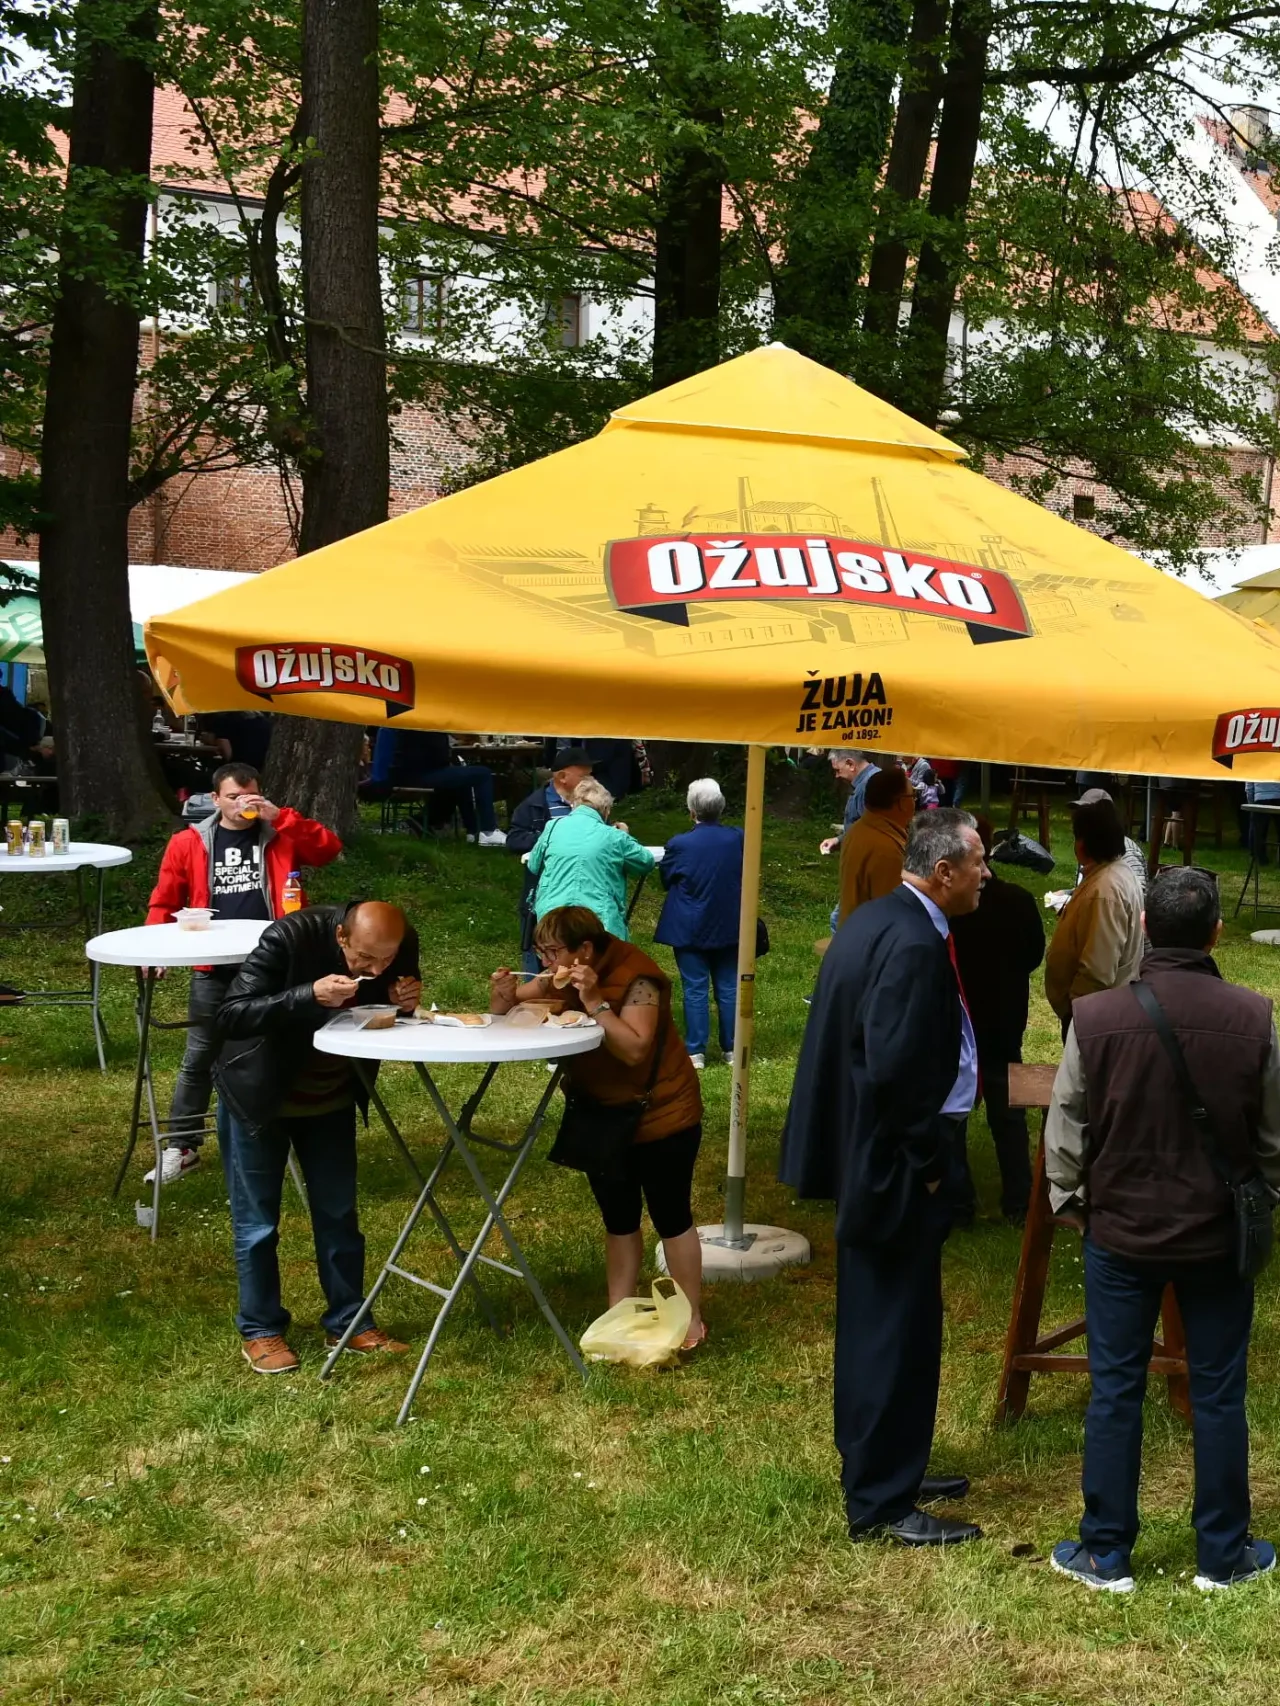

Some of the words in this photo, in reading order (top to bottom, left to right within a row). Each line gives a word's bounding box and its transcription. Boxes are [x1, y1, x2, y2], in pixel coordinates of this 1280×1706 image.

[647, 539, 994, 614] Ožujsko
[253, 648, 400, 692] Ožujsko
[800, 670, 887, 710] ŽUJA
[796, 713, 817, 733] JE
[821, 708, 893, 730] ZAKON!
[842, 730, 853, 740] od
[856, 729, 881, 740] 1892.
[215, 845, 260, 867] .B.I
[215, 865, 253, 876] SPECIAL
[219, 873, 251, 884] YORK
[213, 881, 263, 895] PARTMENT
